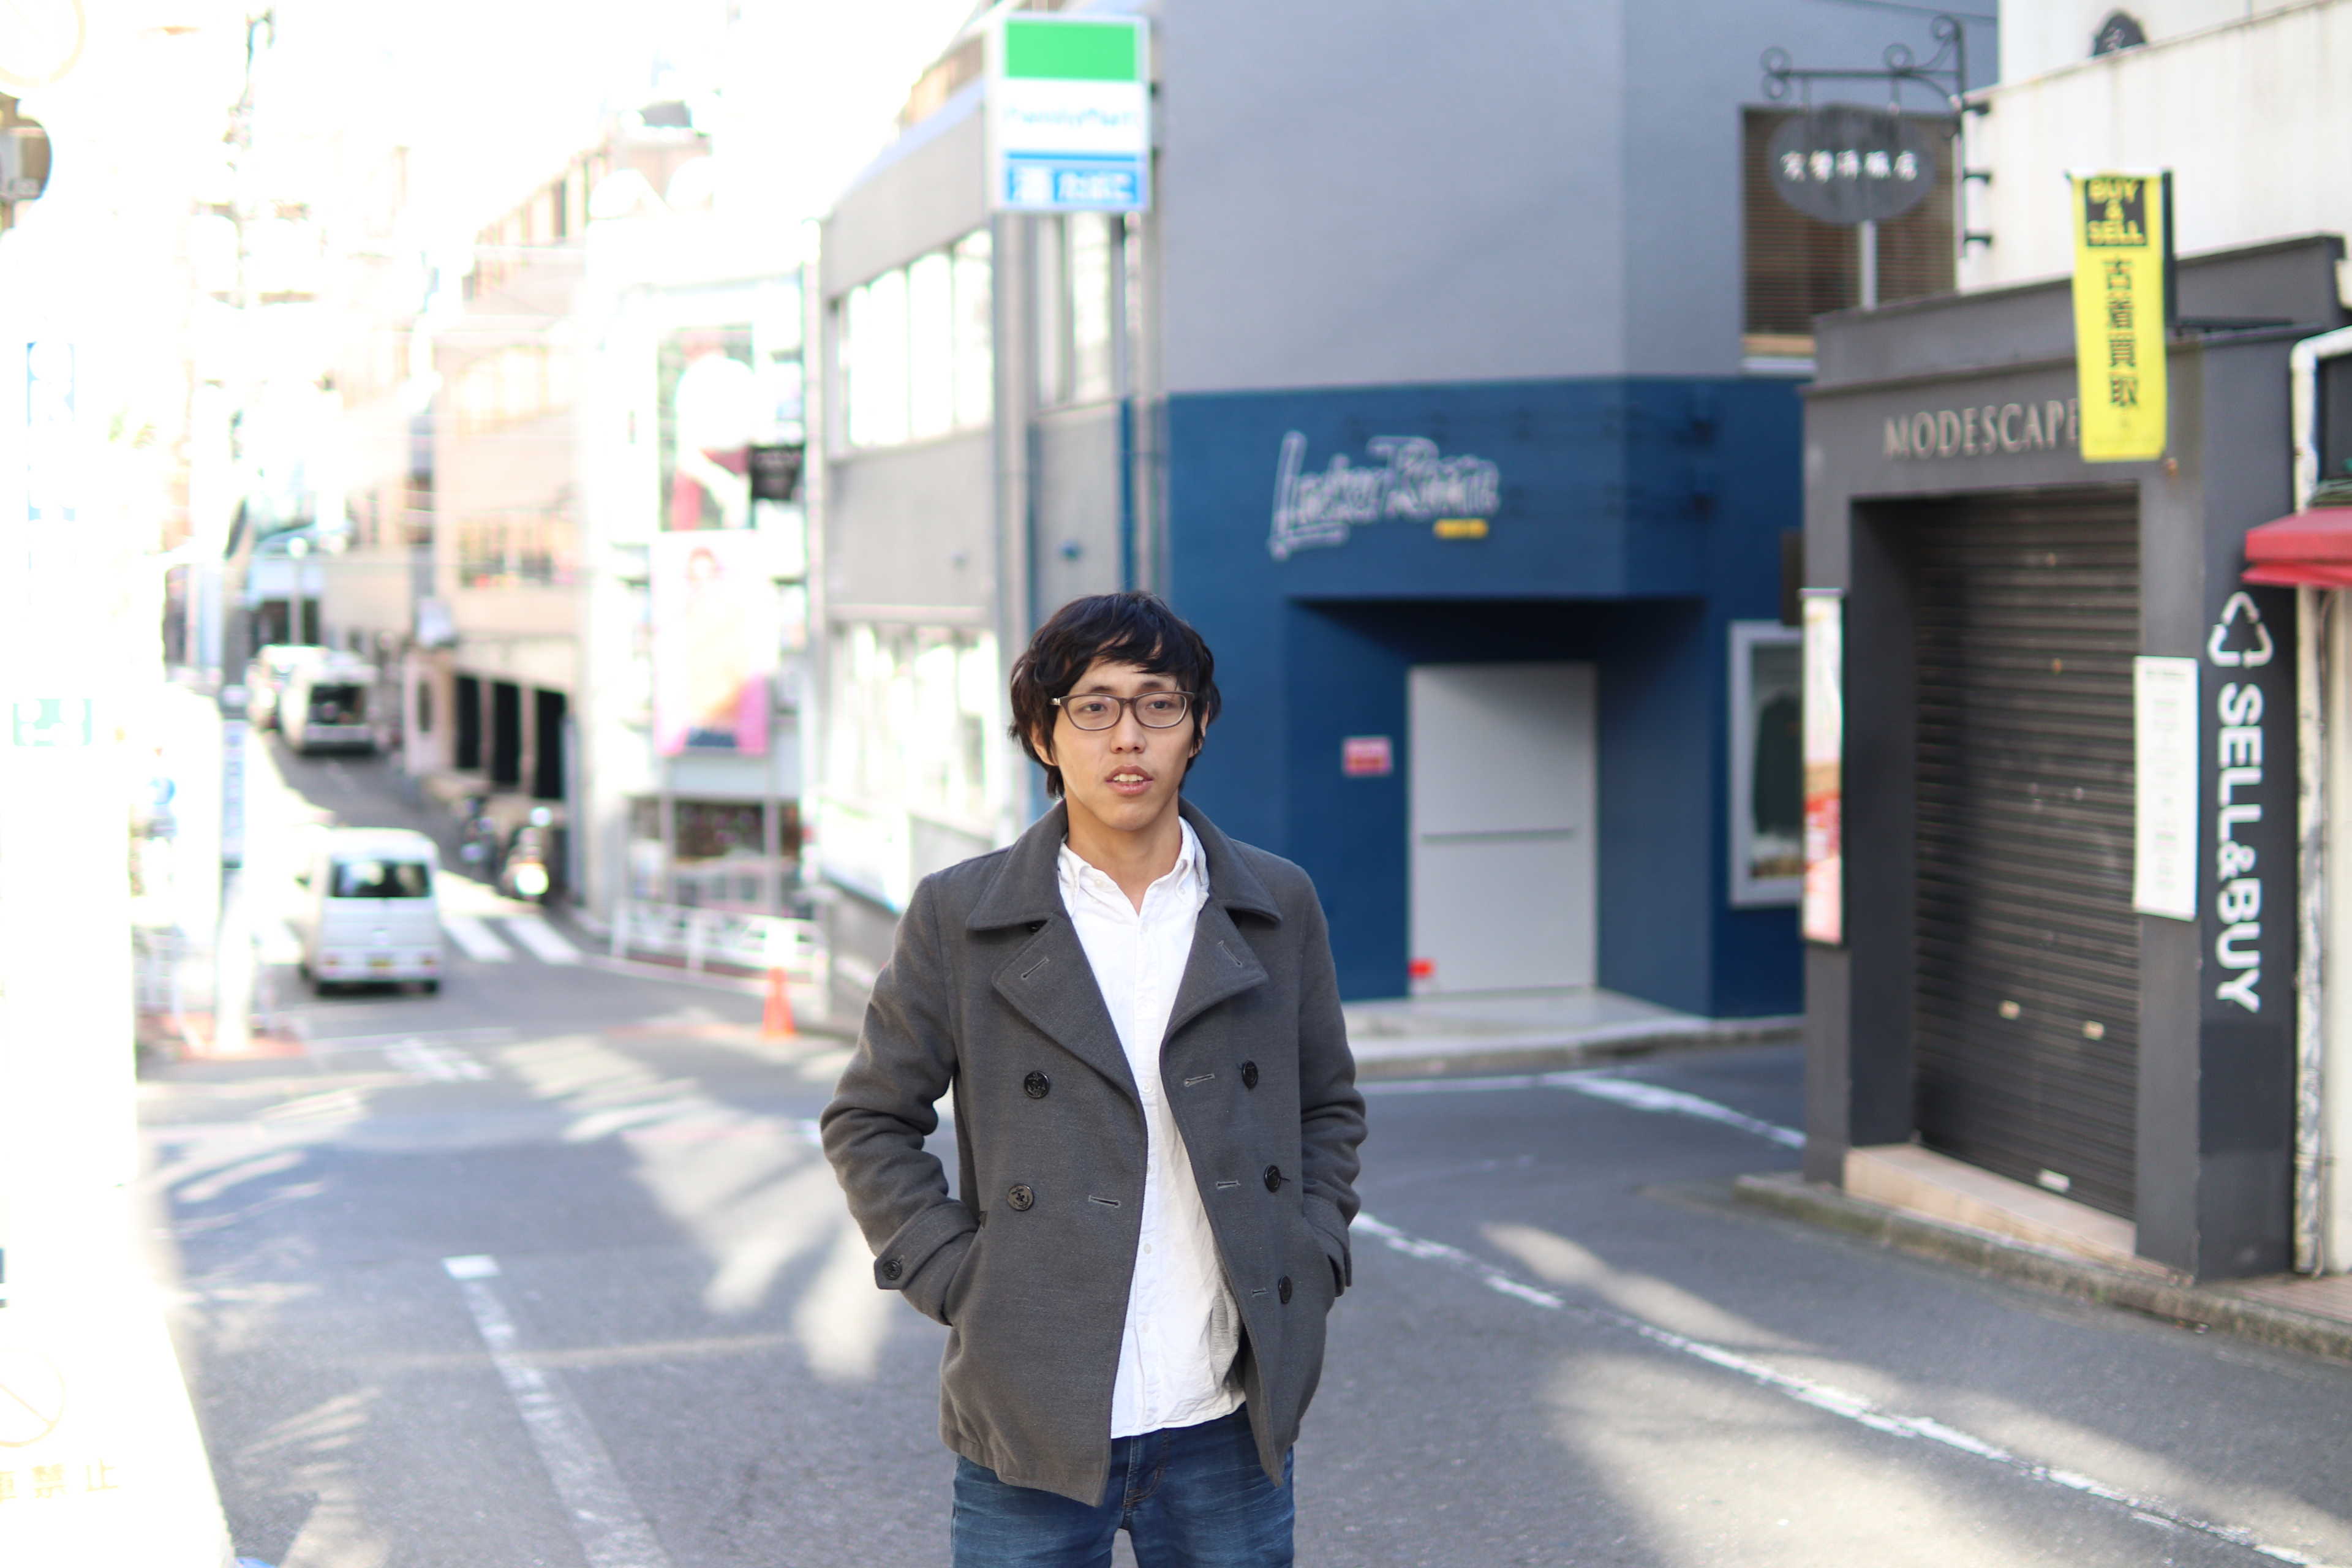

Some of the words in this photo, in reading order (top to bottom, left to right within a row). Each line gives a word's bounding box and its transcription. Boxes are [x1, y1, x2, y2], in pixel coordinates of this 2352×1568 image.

[2088, 179, 2139, 204] BUY
[2087, 220, 2145, 245] SELL
[2102, 255, 2139, 407] 古着買取
[1882, 398, 2079, 459] MODESCAPE
[2215, 682, 2263, 1014] SELL&BUY
